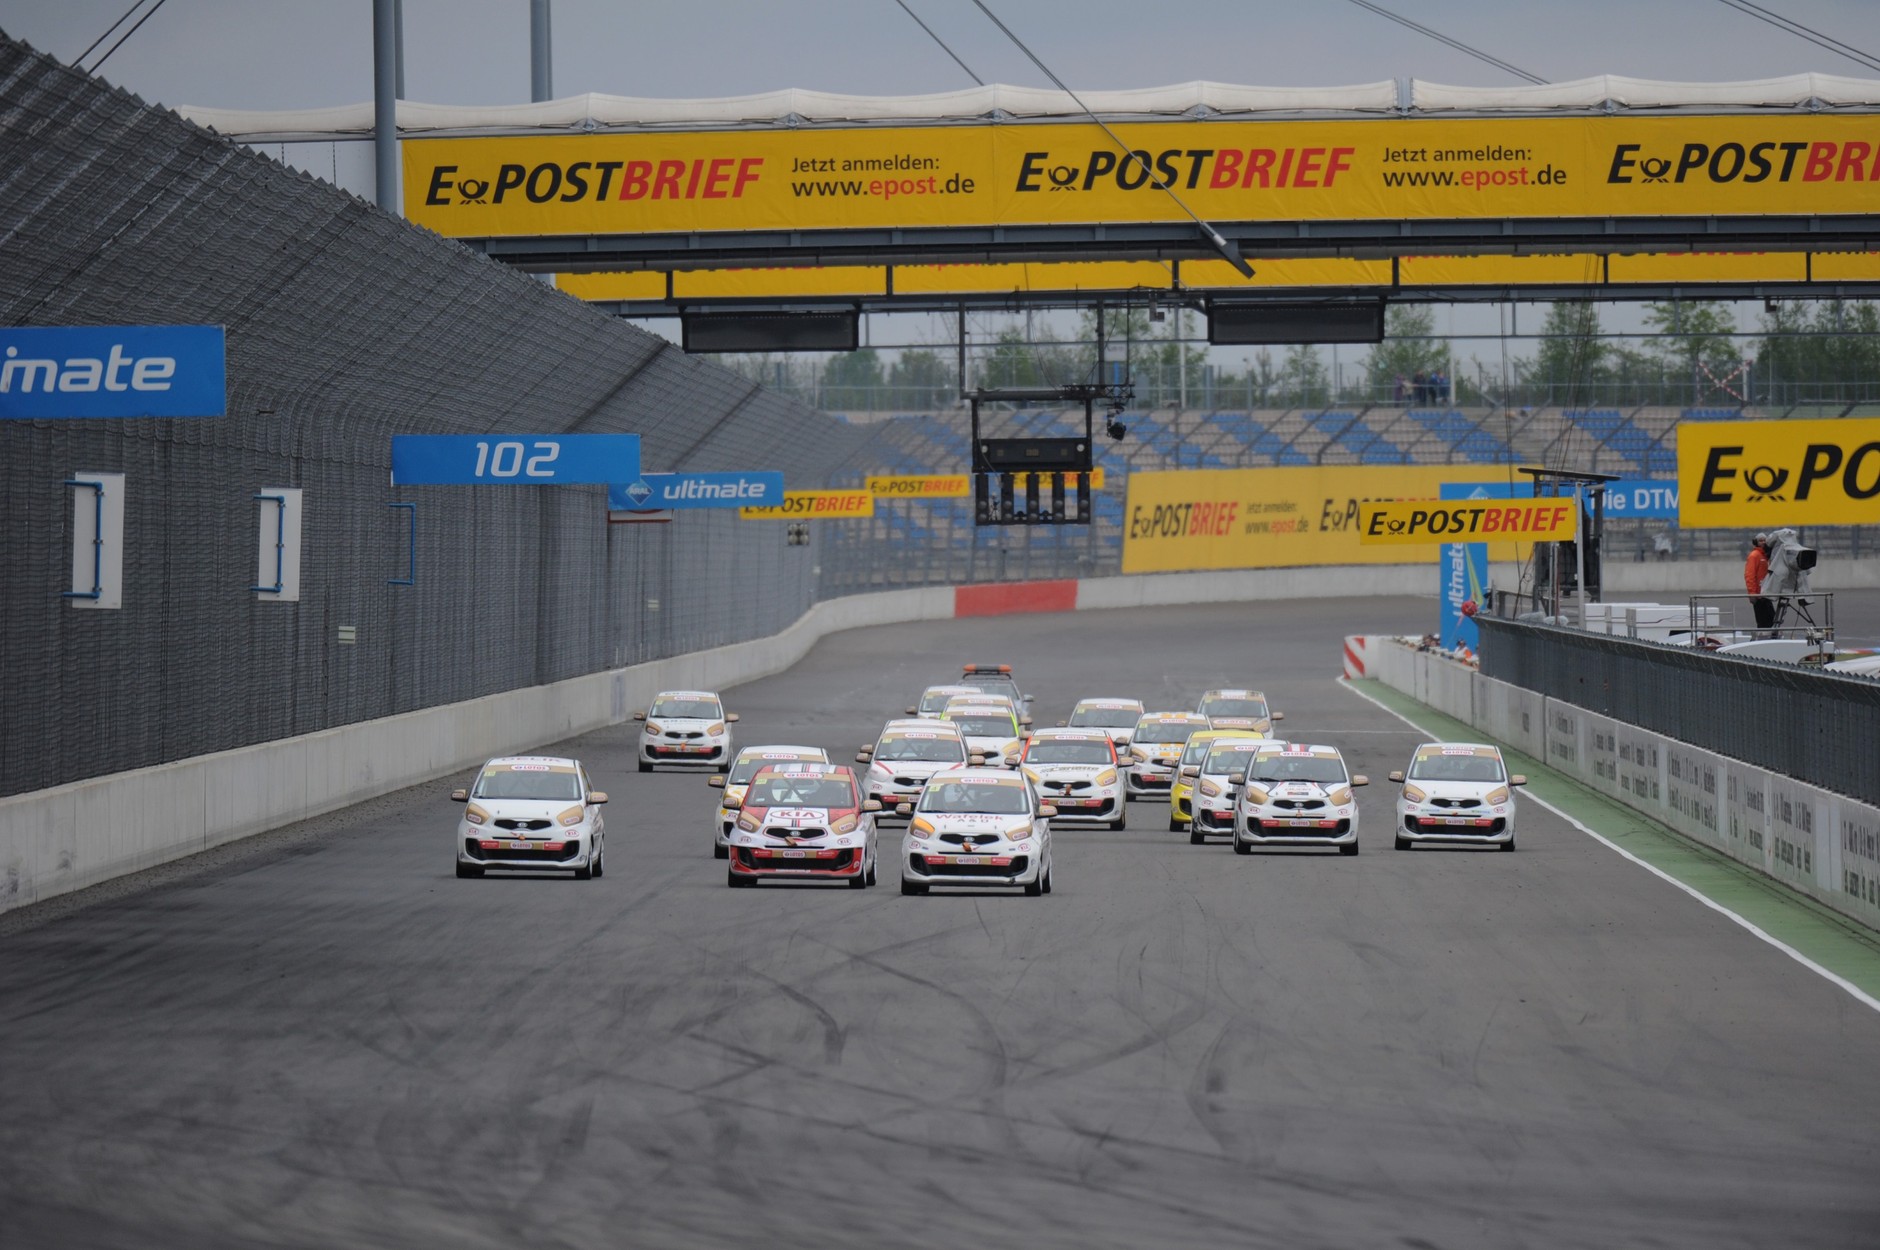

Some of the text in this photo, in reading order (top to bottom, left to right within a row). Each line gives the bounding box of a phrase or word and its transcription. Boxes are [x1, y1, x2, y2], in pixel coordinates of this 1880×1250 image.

[791, 154, 940, 173] Jetzt anmelden:
[1383, 145, 1532, 162] Jetzt anmelden:
[791, 172, 975, 201] www.epost.de
[1382, 164, 1567, 192] www.epost.de
[474, 441, 561, 478] 102
[663, 479, 766, 499] ultimate
[1634, 487, 1680, 510] DTM
[1245, 516, 1309, 537] www.epost.de
